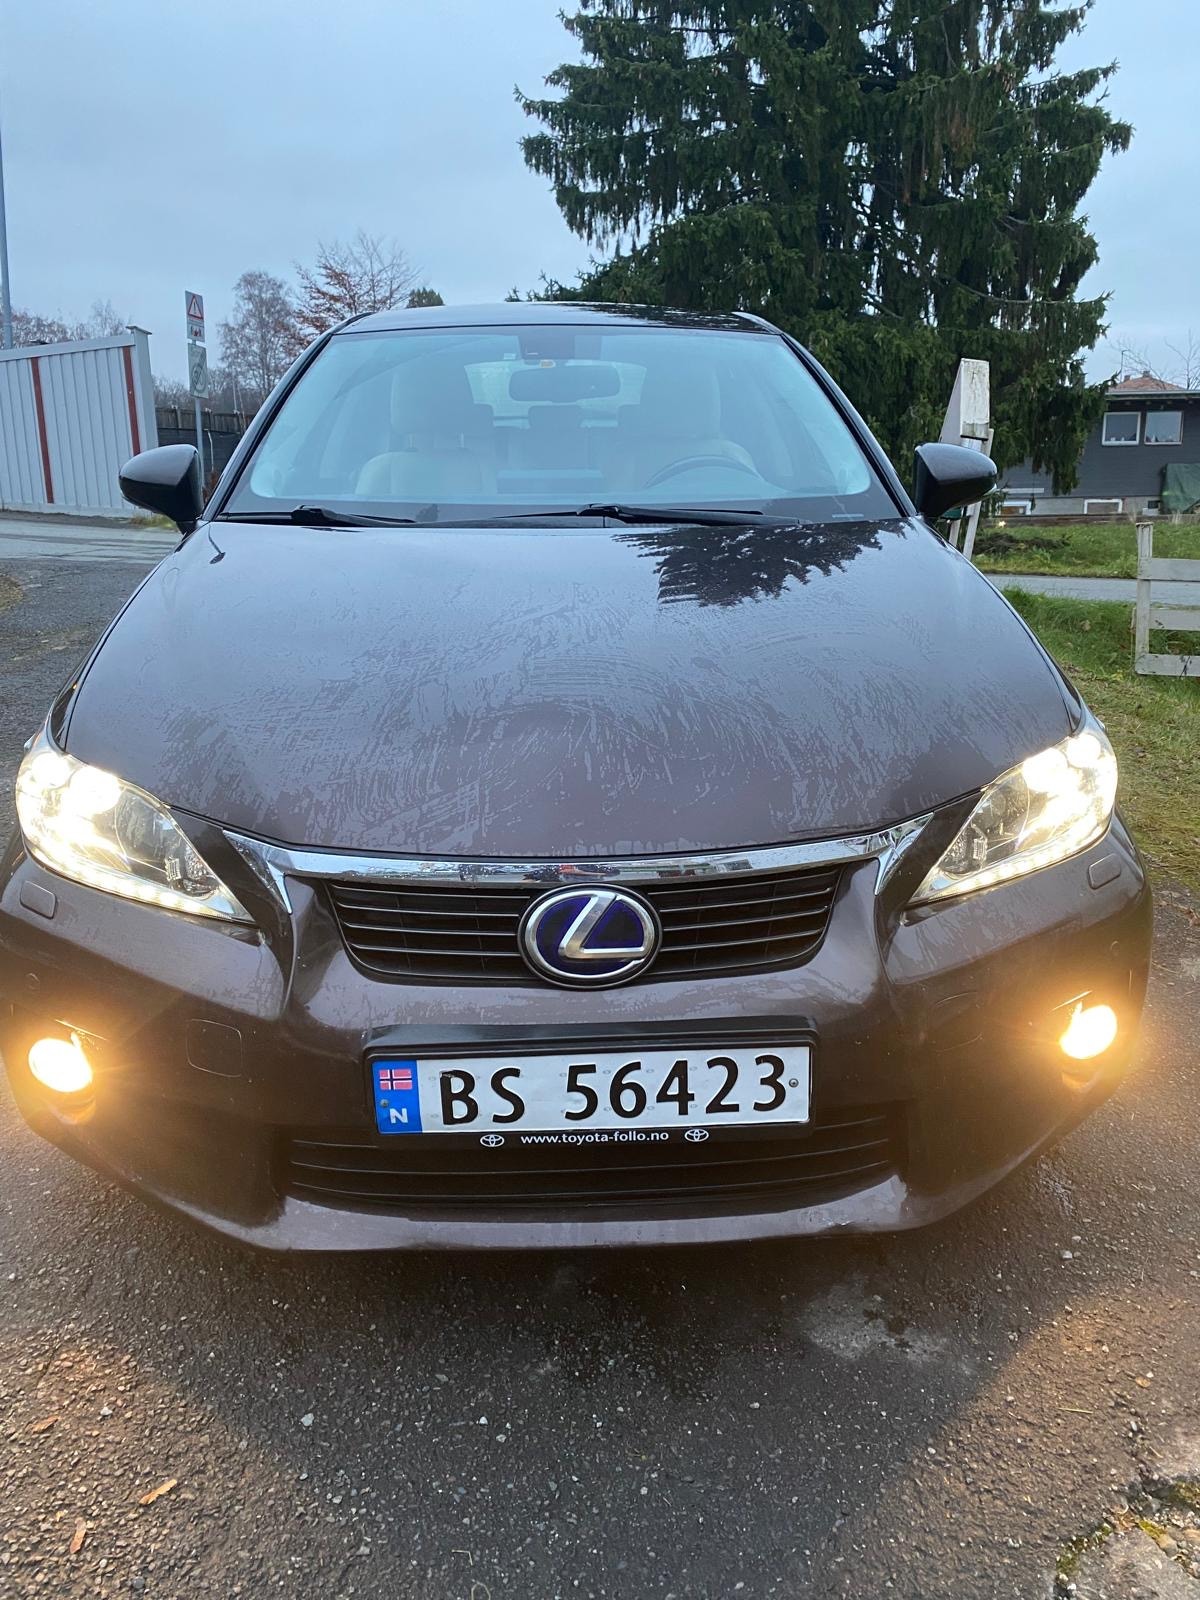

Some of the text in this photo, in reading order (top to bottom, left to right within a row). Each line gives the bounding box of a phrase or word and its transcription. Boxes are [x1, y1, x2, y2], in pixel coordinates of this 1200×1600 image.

[440, 1054, 787, 1125] BS 56423
[389, 1107, 409, 1125] N
[520, 1130, 669, 1145] www.toyota-follo.no
